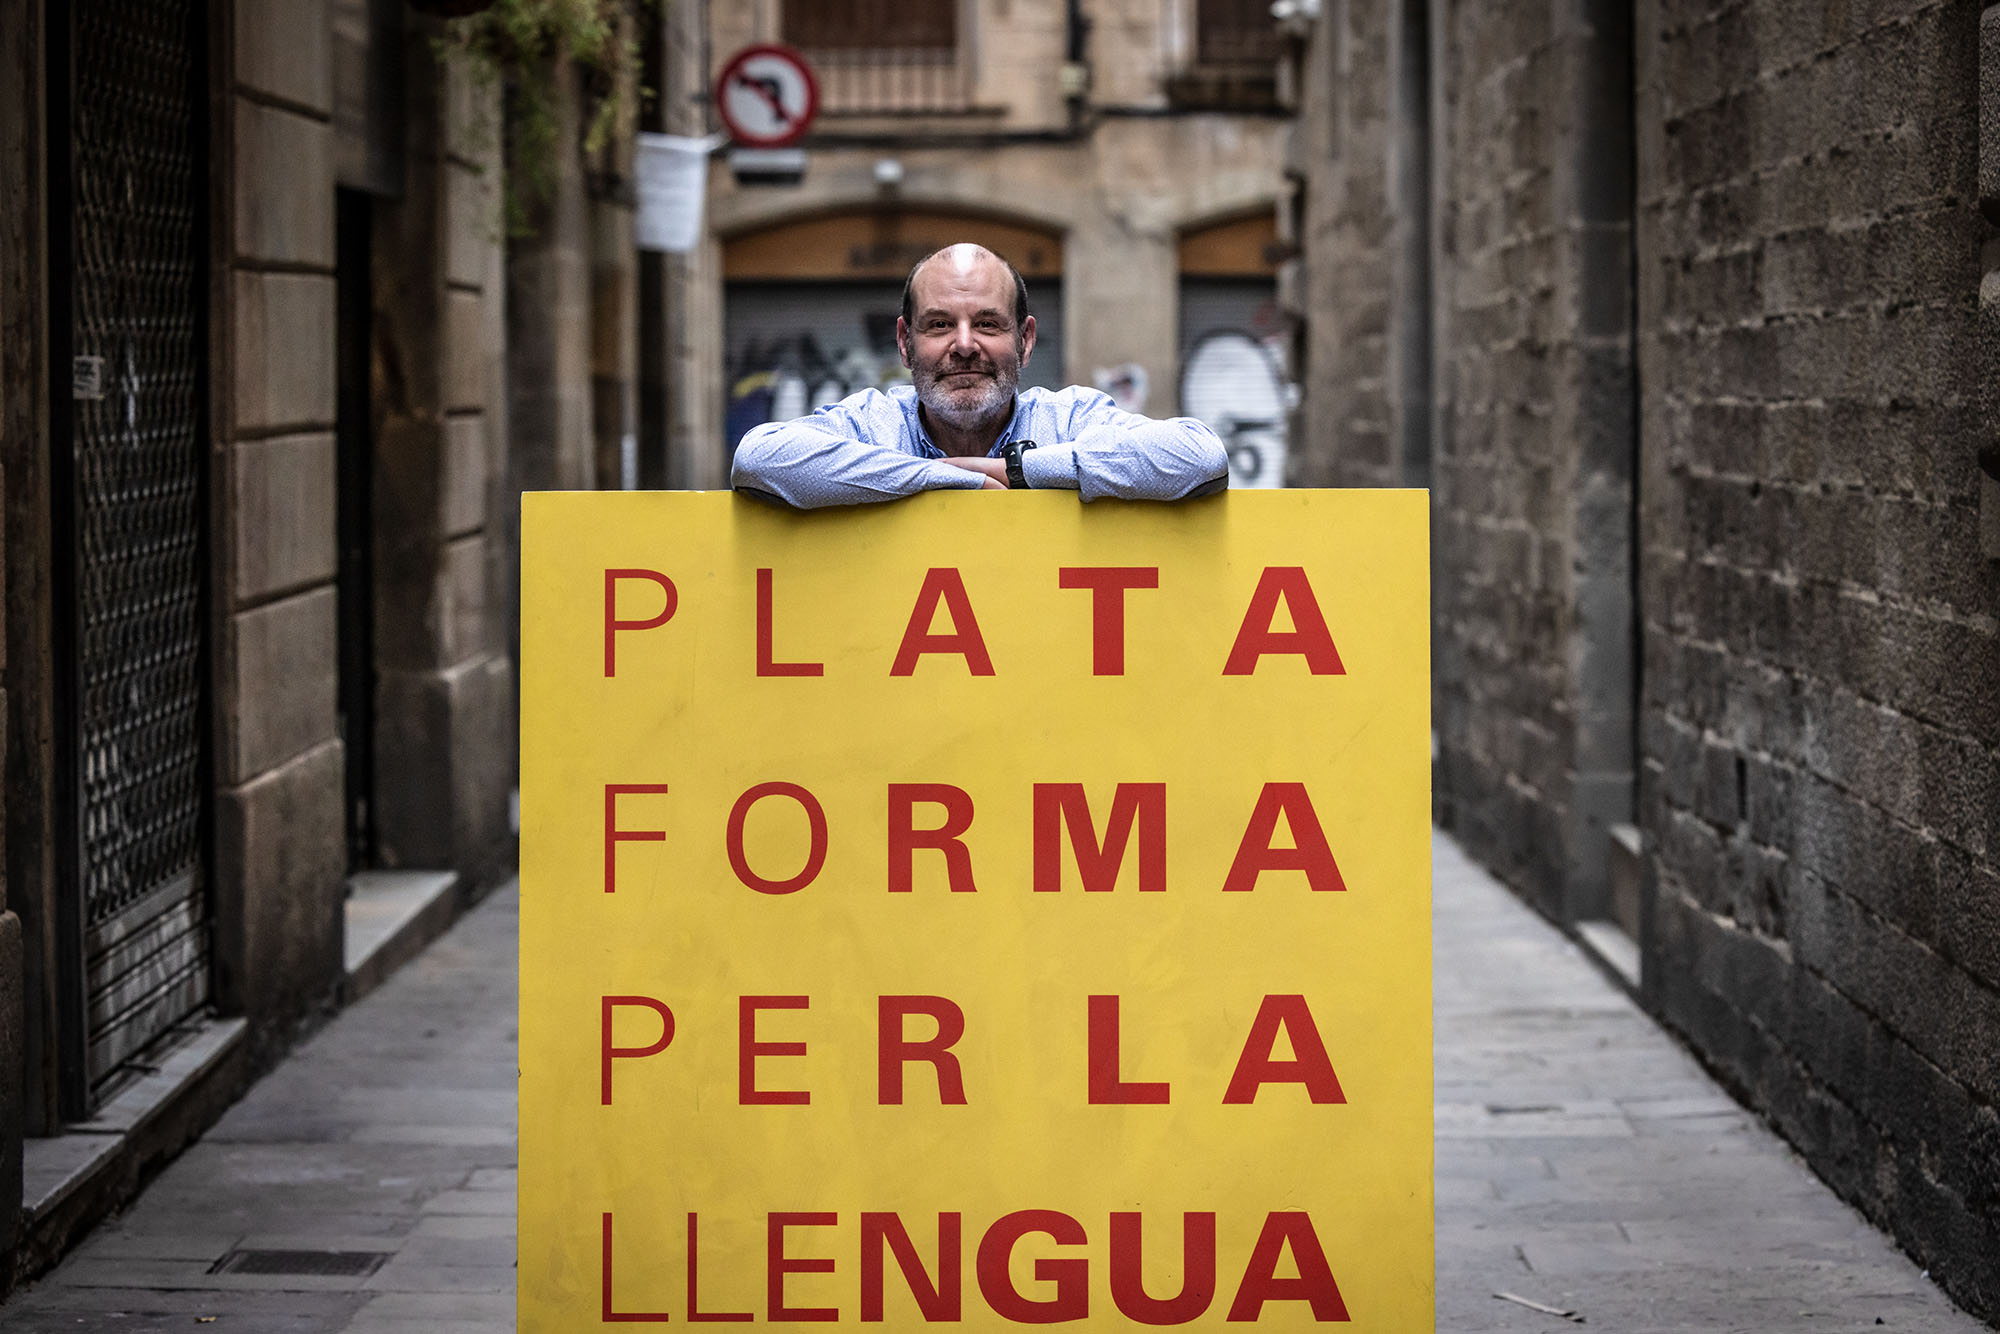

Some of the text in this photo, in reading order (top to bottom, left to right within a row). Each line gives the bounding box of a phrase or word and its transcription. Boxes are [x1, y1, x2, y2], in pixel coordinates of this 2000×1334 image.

[604, 566, 1347, 678] PLATA
[604, 781, 1347, 894] FORMA
[601, 994, 1348, 1106] PER LA
[601, 1208, 1351, 1326] LLENGUA
